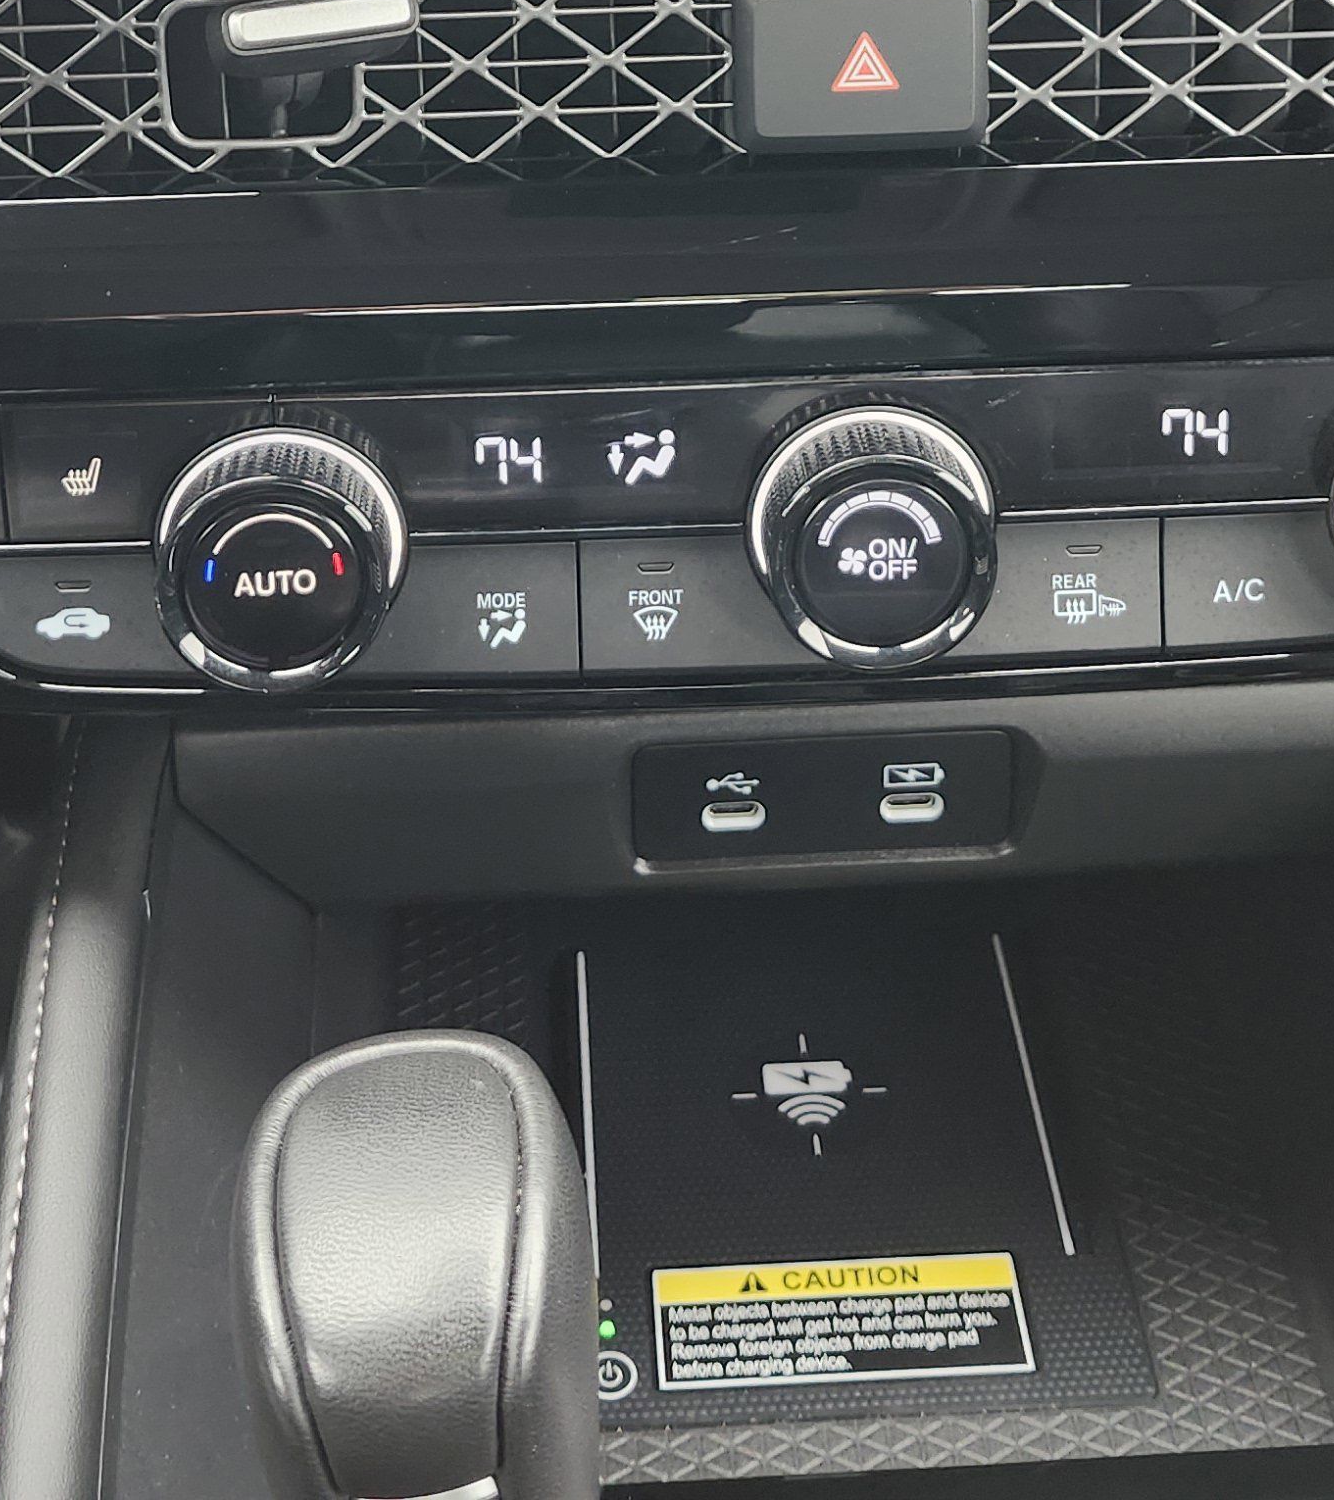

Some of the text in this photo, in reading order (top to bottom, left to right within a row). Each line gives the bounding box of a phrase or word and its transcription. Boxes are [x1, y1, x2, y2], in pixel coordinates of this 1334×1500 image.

[1160, 407, 1230, 457] 74
[473, 435, 542, 485] 74
[868, 537, 918, 560] ON/
[868, 558, 918, 582] OFF
[1052, 574, 1097, 589] REAR
[234, 569, 317, 598] AUTO
[1213, 578, 1265, 604] A/C
[477, 593, 526, 609] MODE
[628, 590, 684, 607] FRONT
[783, 1264, 920, 1290] CAUTION
